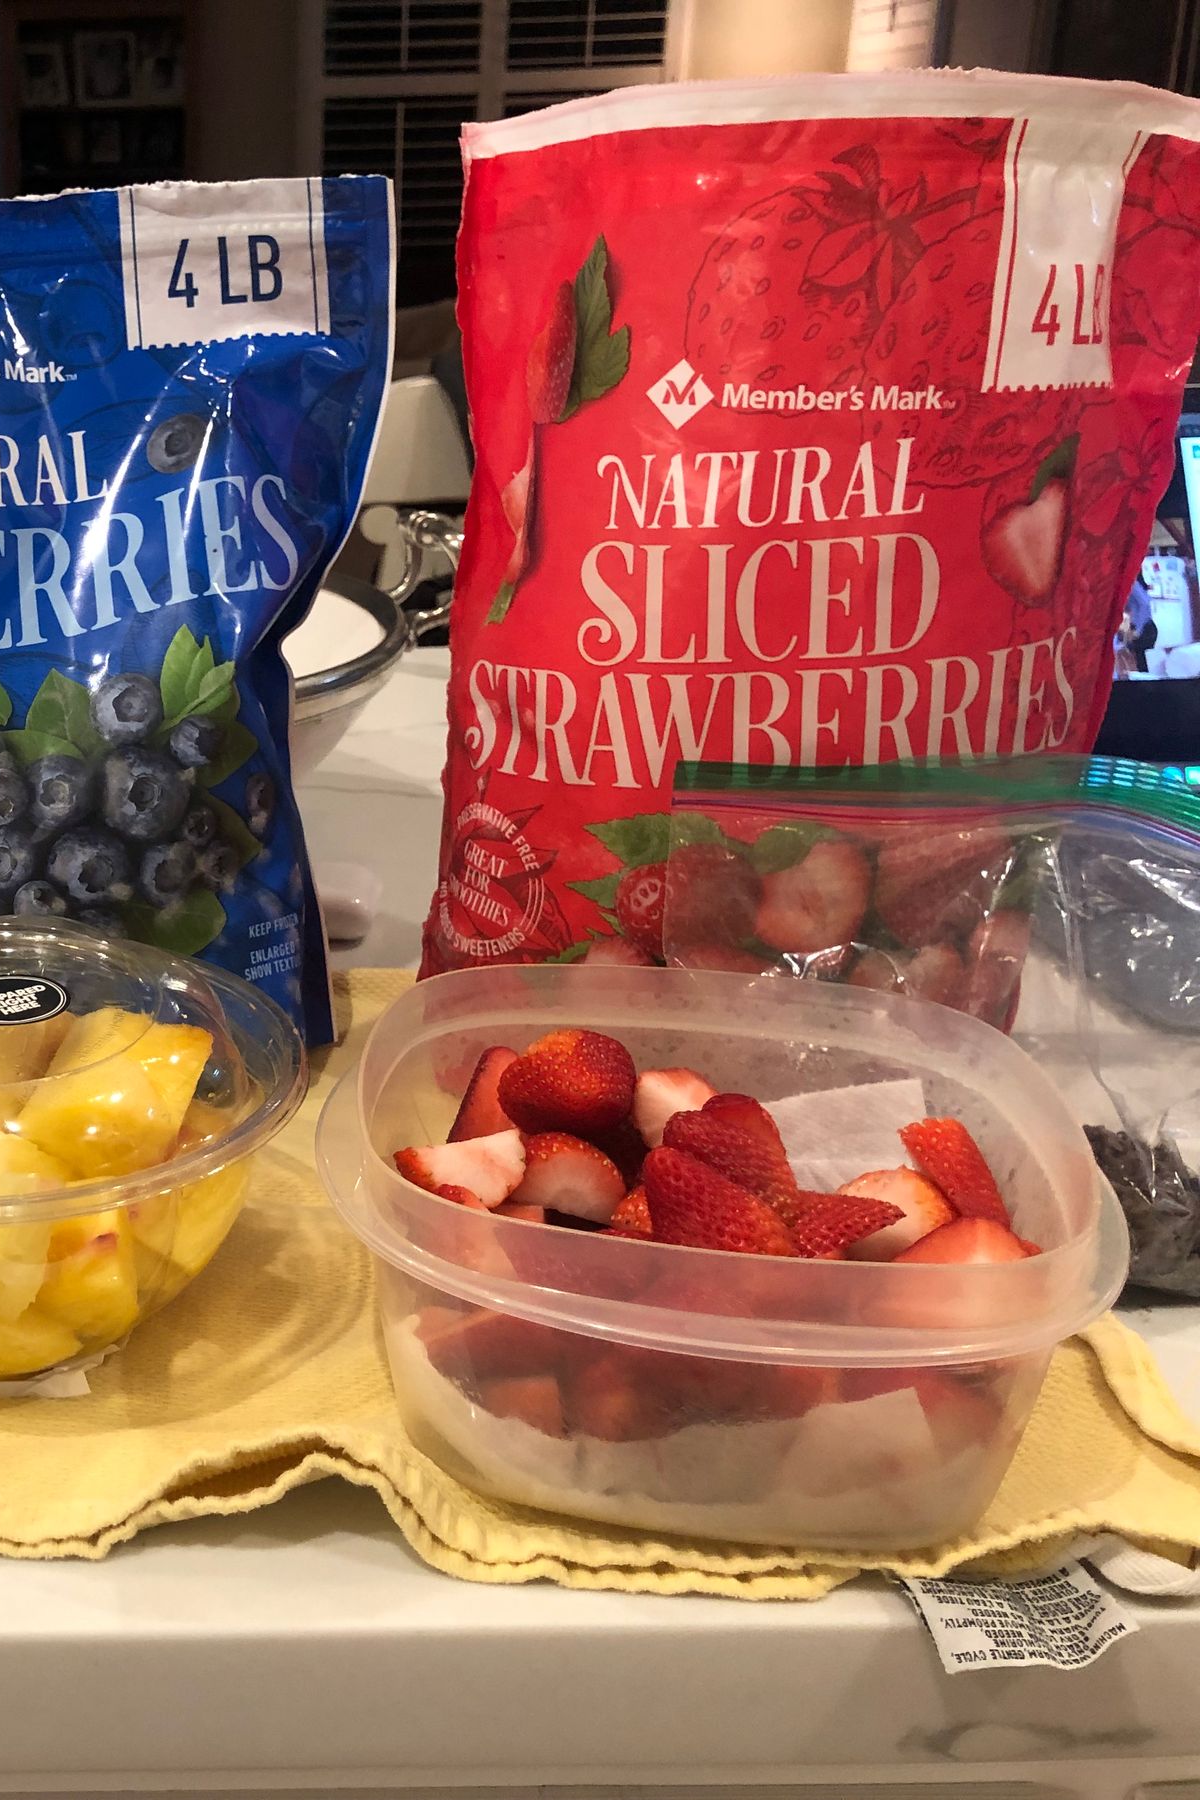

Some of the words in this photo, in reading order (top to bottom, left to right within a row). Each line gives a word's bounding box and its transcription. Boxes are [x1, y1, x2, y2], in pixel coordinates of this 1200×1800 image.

[167, 238, 199, 308] 4
[217, 235, 283, 305] LB
[1031, 264, 1061, 346] 4
[721, 383, 864, 411] Member's
[597, 437, 925, 530] NATURAL
[576, 532, 941, 667] SLICED
[464, 625, 1079, 789] STRAWBERRIES
[463, 838, 509, 879] GREAT
[512, 835, 541, 872] FREE
[464, 864, 491, 894] FOR
[248, 921, 272, 939] KEEP
[453, 927, 525, 957] SWEETENERS
[249, 941, 296, 964] ENLARGED
[244, 963, 272, 981] SHOW
[0, 1000, 41, 1015] HERE
[940, 1618, 996, 1629] PROMPTLY,
[1091, 1622, 1127, 1655] MACHINE
[951, 1650, 987, 1664] CYCLE,
[989, 1649, 1026, 1660] GENTLE
[1061, 1655, 1092, 1666] WASH
